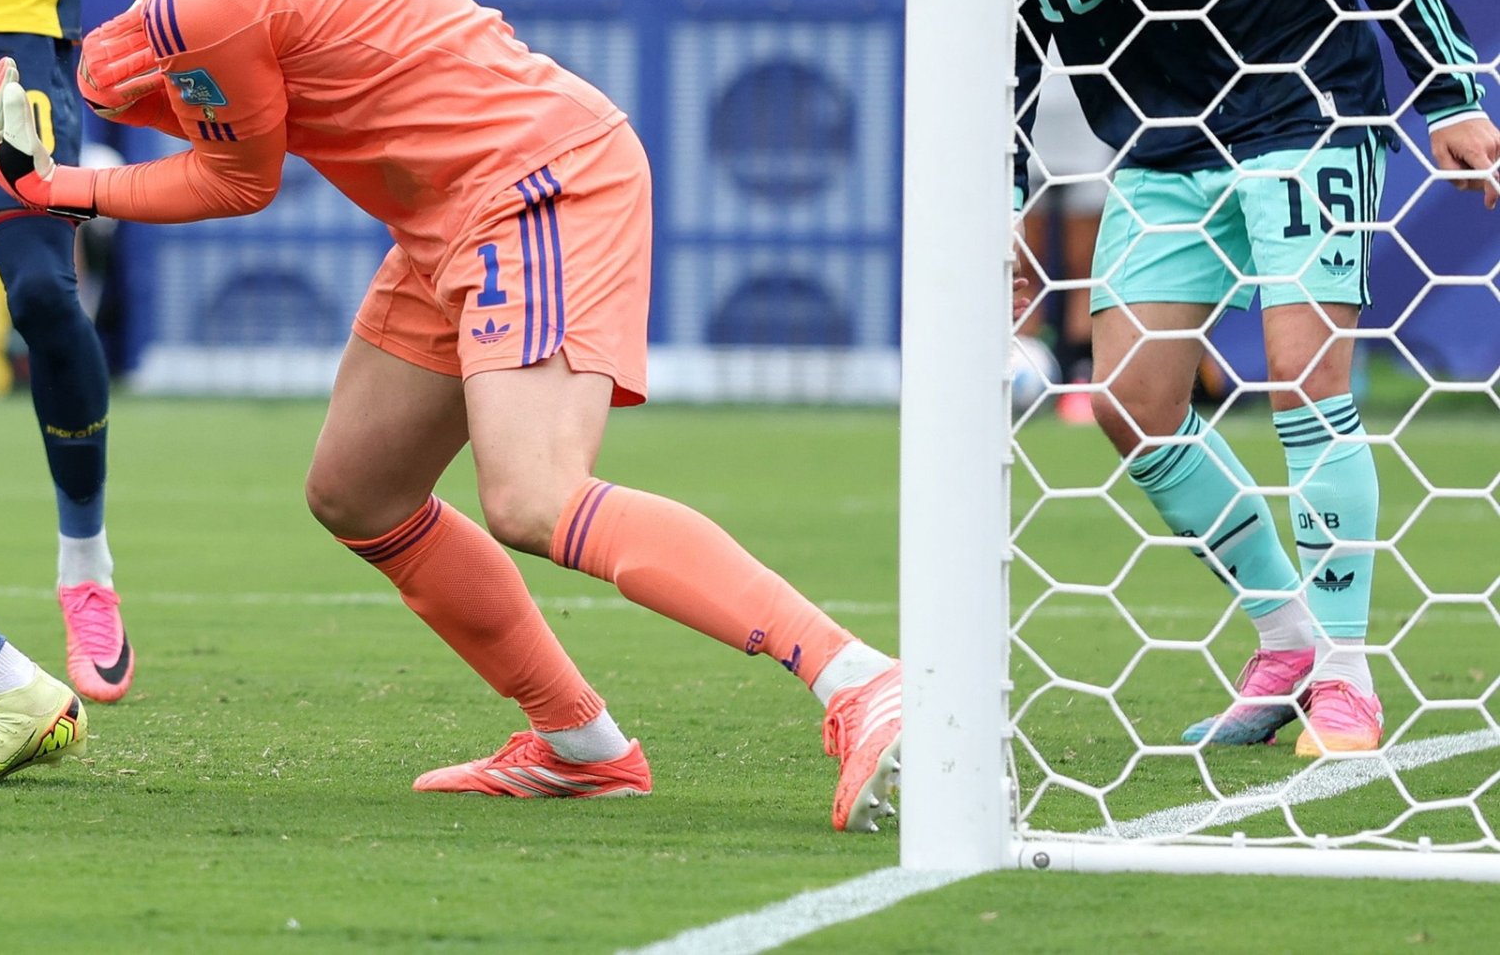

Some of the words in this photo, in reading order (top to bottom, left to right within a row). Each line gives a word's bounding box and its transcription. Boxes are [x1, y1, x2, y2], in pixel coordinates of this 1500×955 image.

[1281, 167, 1356, 239] 16
[476, 243, 507, 307] 1
[1298, 512, 1340, 530] DFB
